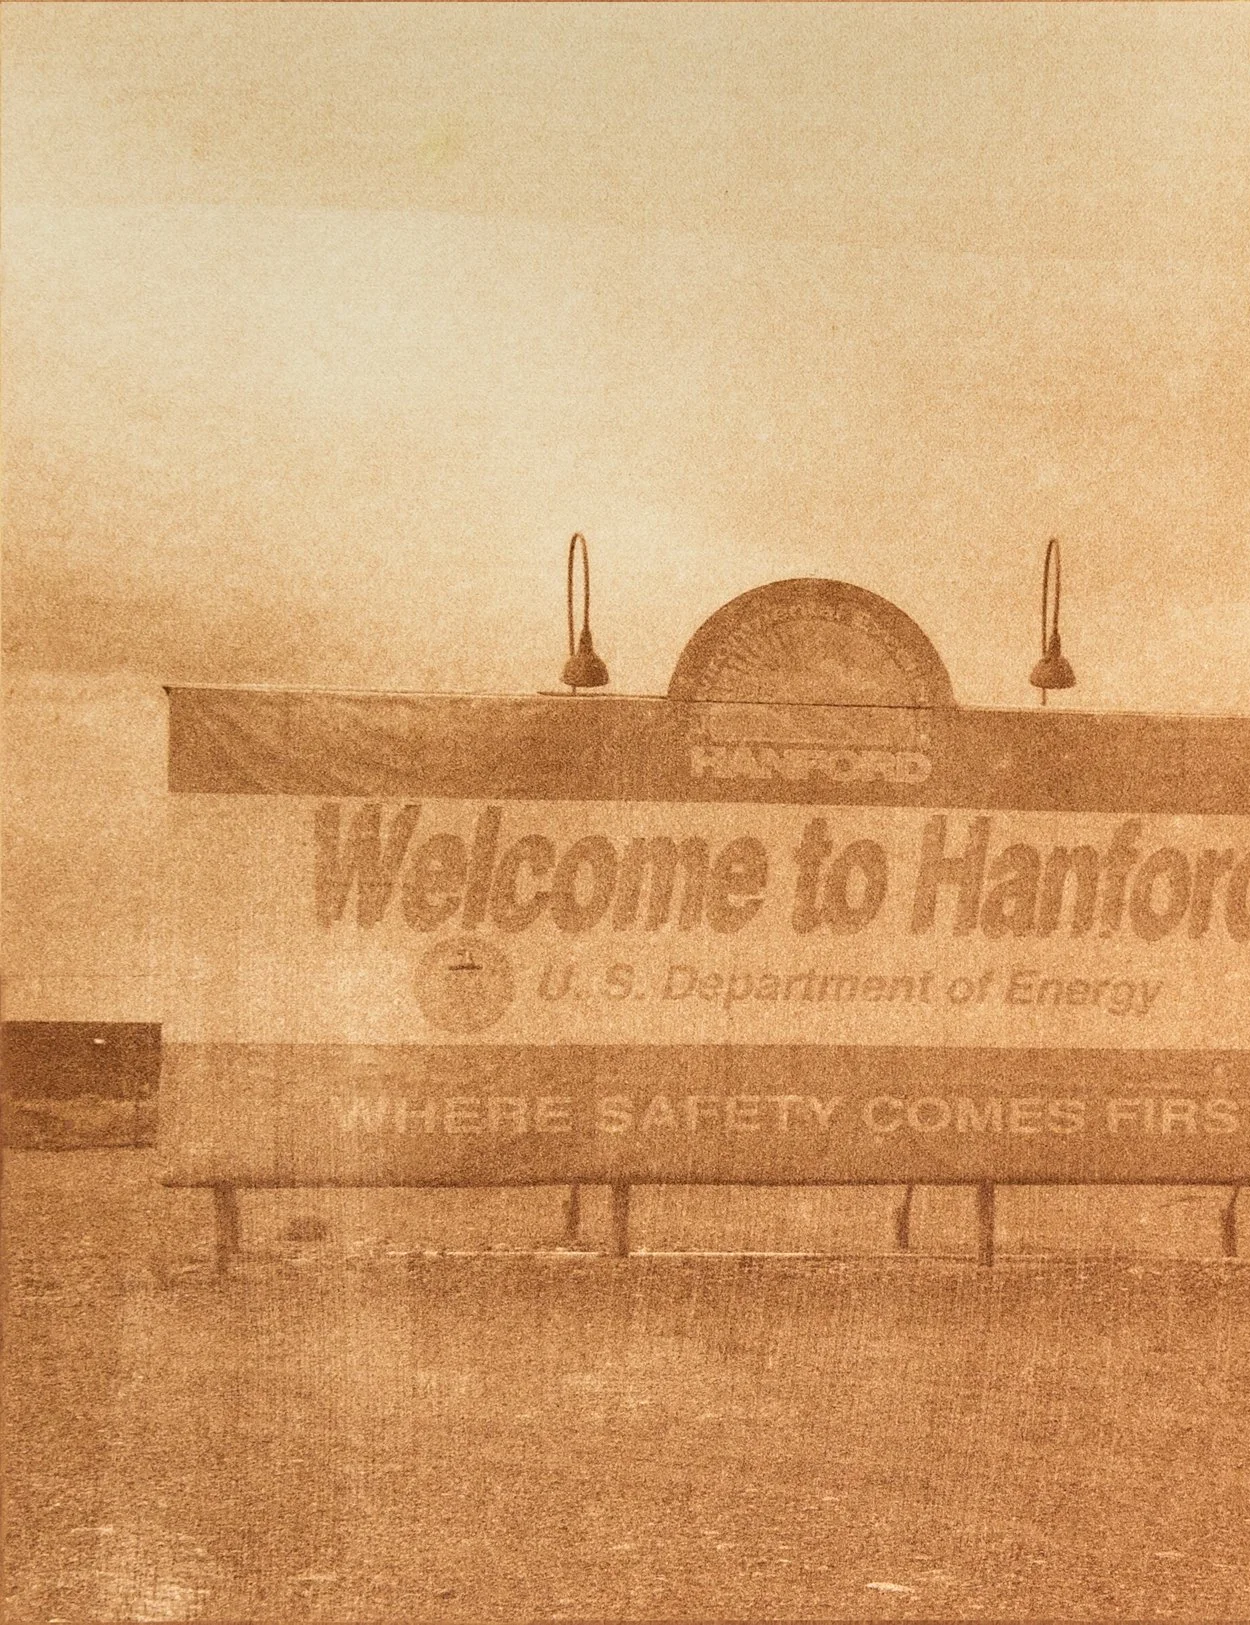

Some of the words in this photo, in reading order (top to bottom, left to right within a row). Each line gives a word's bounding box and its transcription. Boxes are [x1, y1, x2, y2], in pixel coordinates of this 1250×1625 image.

[690, 746, 933, 784] HANFORD
[313, 804, 768, 934] Welcome
[794, 817, 888, 934] to
[663, 965, 930, 1011] Department
[948, 968, 990, 1006] of
[1004, 969, 1163, 1015] Energy
[331, 1095, 573, 1134] WHERE
[597, 1093, 843, 1134] SAFETY
[862, 1095, 1087, 1135] COMES
